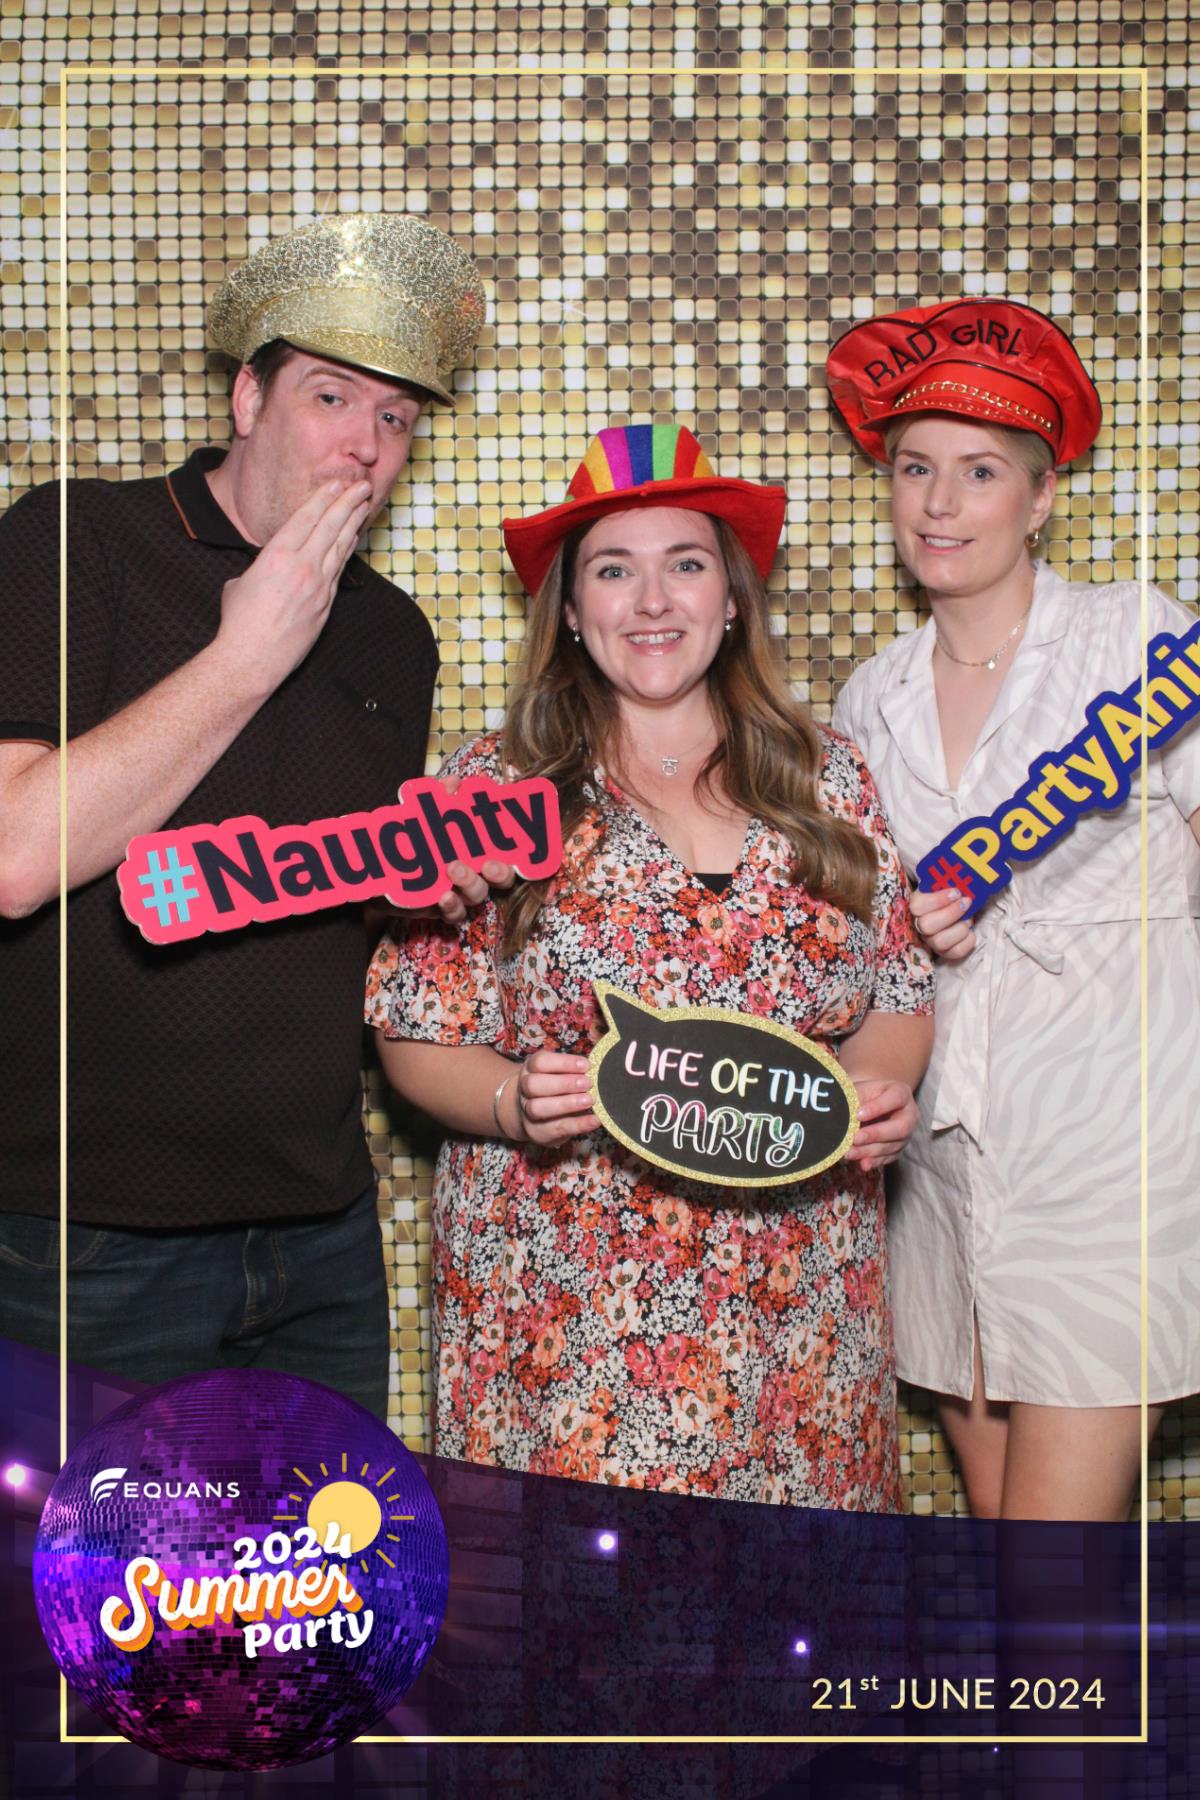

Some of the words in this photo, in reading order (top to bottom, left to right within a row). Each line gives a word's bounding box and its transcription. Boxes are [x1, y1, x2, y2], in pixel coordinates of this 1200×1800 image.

[864, 328, 937, 387] BAD
[951, 319, 1022, 356] GIRL
[928, 636, 1200, 899] #PartyAni
[138, 791, 546, 927] #Naughty
[624, 1041, 704, 1087] LIFE
[710, 1057, 763, 1097] OF
[768, 1067, 835, 1113] THE
